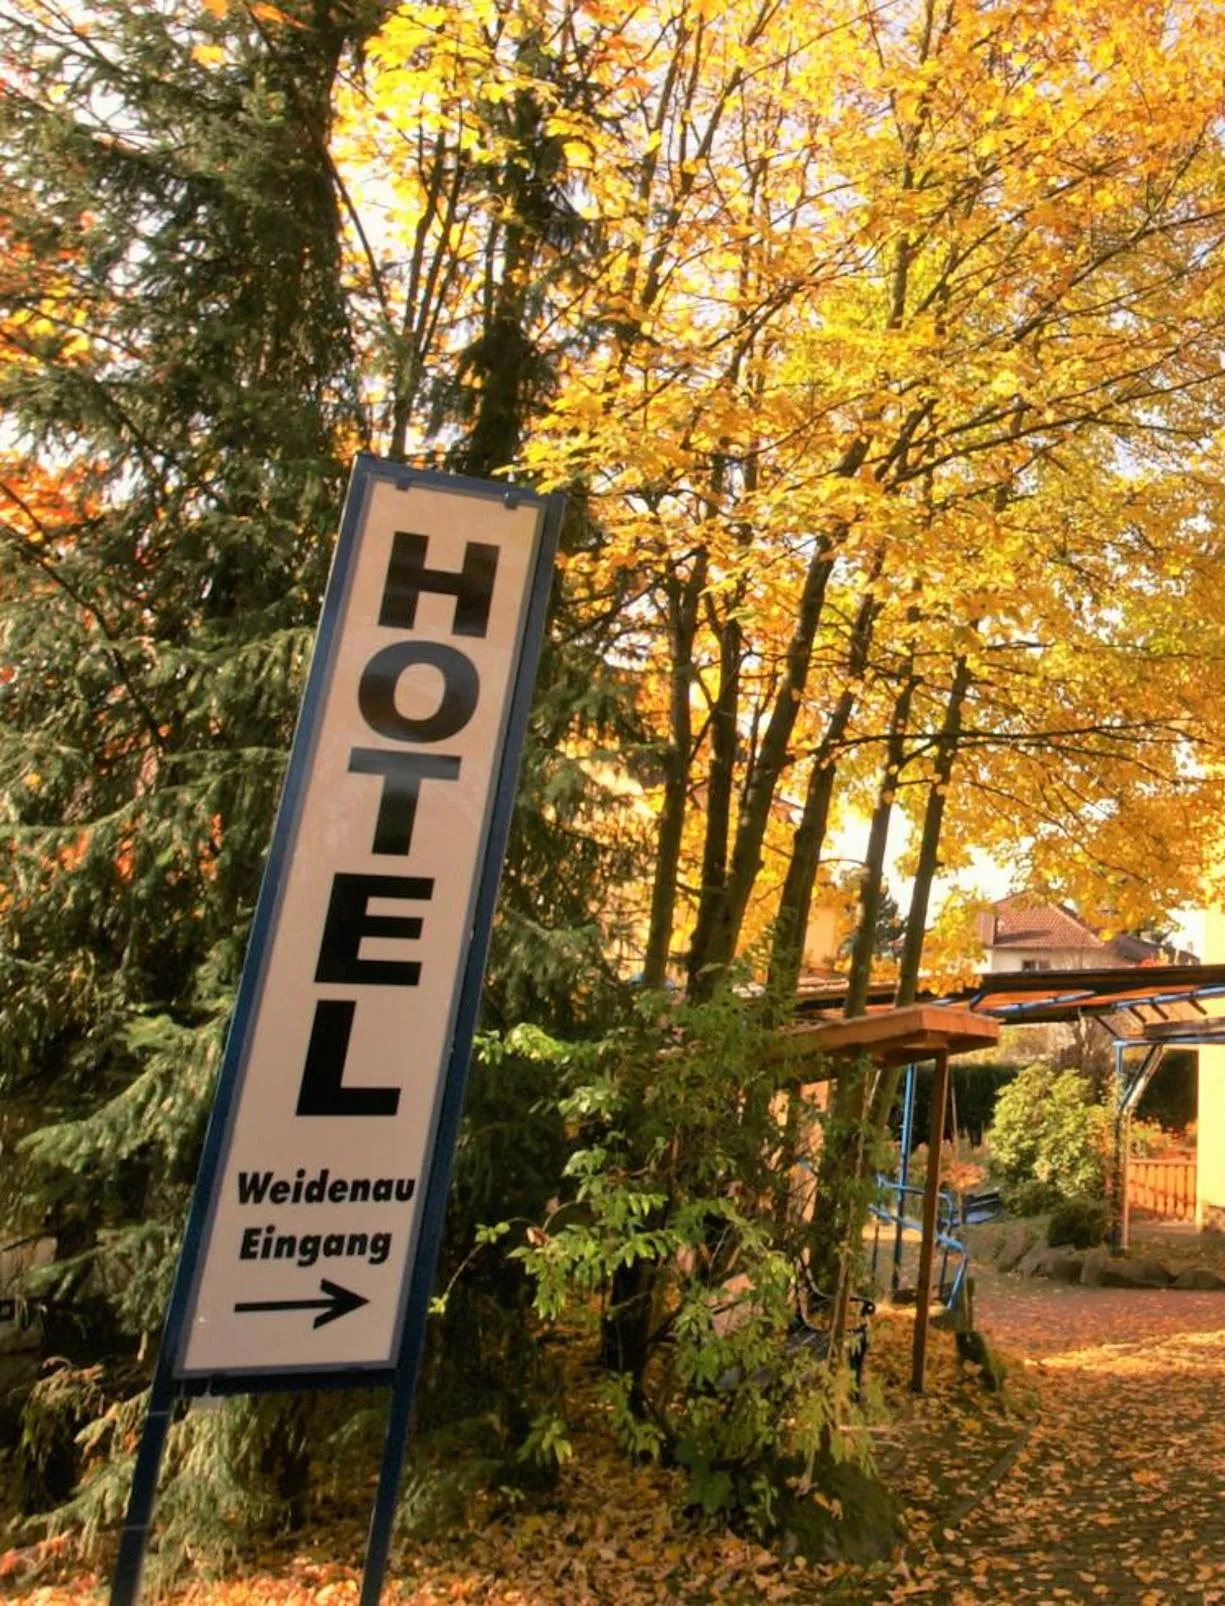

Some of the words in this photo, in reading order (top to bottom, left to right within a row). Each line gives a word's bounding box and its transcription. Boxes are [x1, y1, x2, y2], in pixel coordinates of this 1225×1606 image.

[296, 532, 500, 1117] HOTEL
[237, 1169, 416, 1205] Weidenau
[238, 1225, 392, 1267] Eingang
